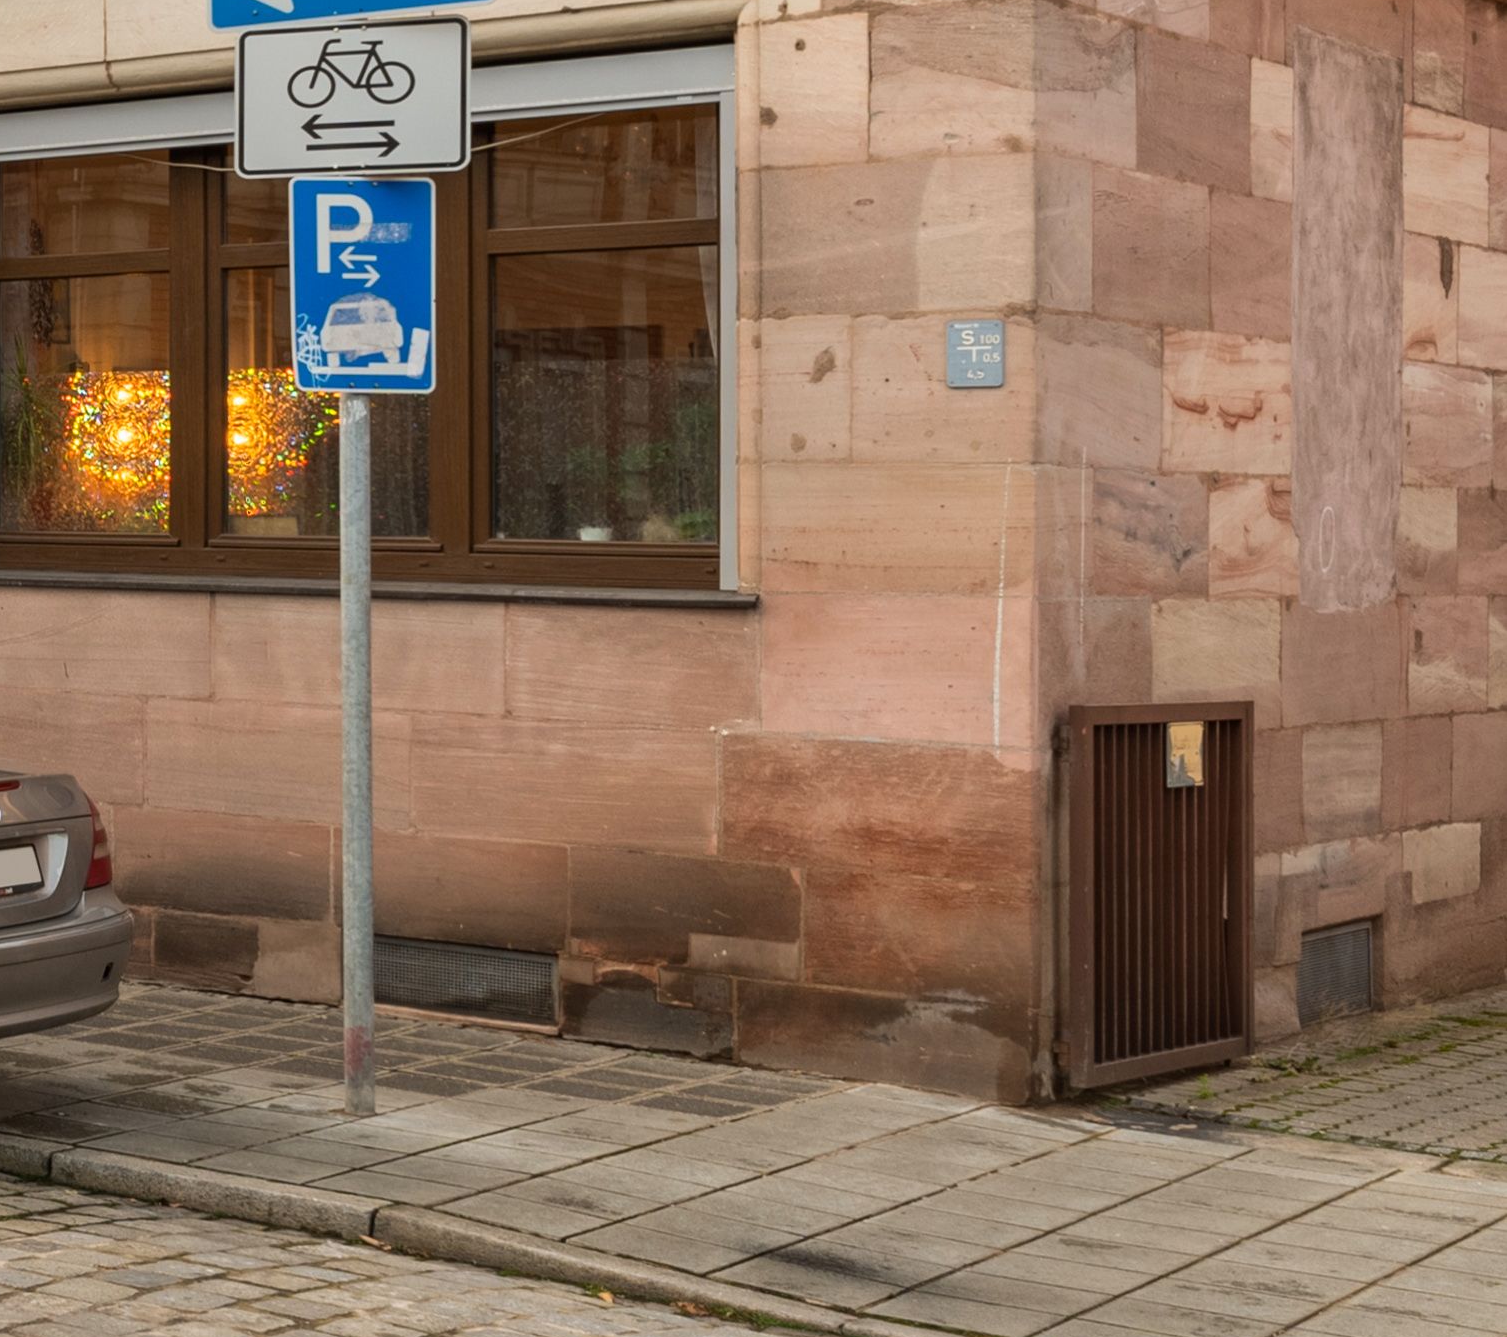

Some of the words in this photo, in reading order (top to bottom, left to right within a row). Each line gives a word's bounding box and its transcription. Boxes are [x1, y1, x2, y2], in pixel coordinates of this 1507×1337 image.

[315, 193, 375, 275] P
[961, 330, 975, 345] S
[980, 334, 1000, 344] 100
